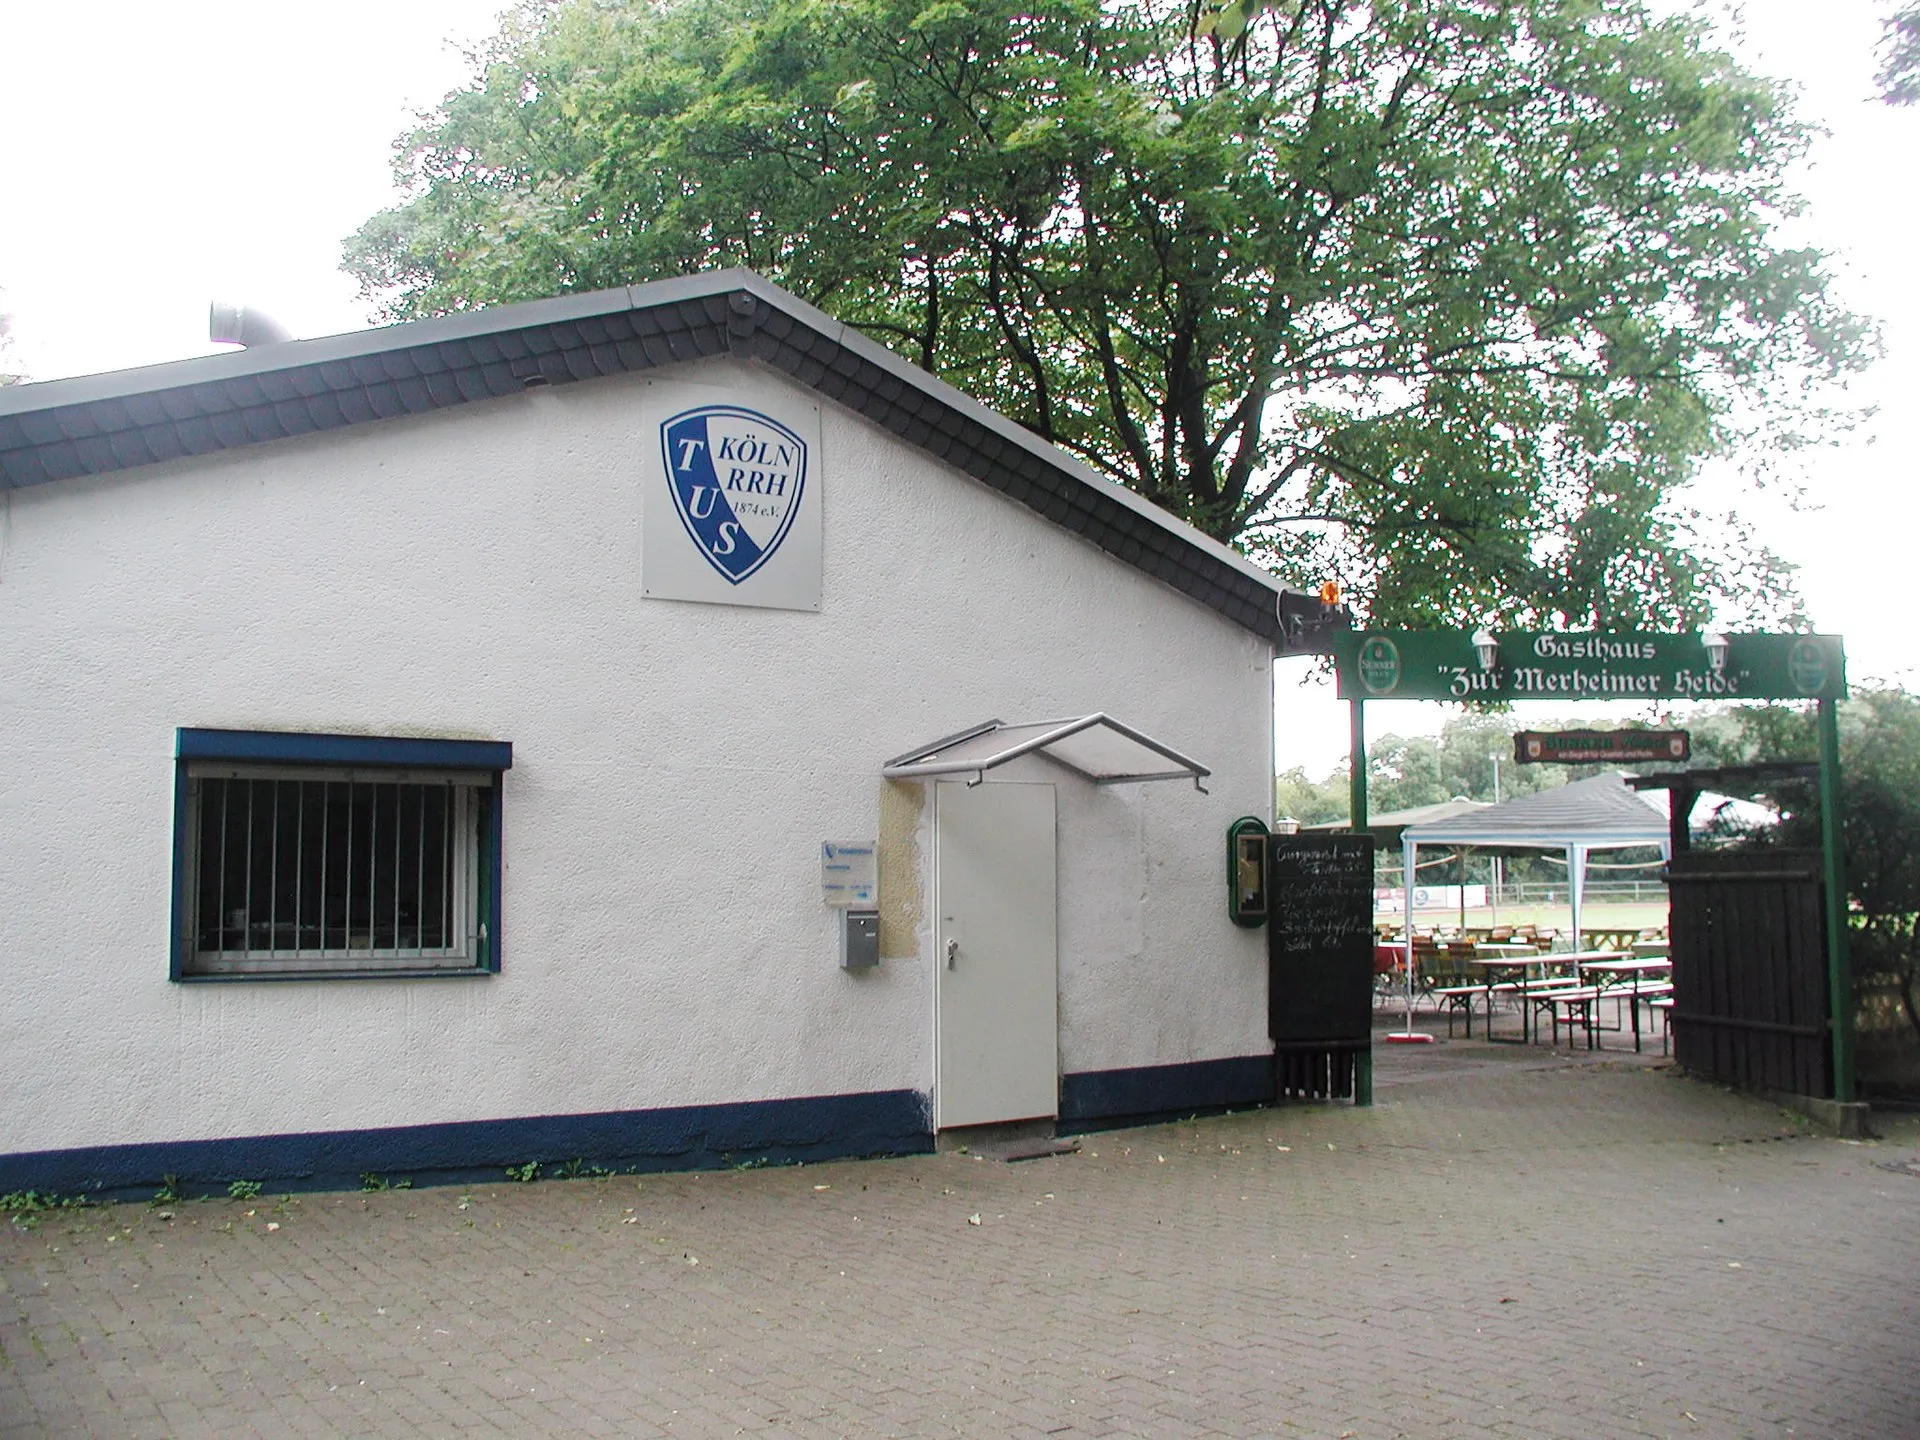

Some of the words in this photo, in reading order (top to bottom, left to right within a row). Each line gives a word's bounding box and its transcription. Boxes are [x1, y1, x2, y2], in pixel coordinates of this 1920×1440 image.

[717, 433, 795, 468] KÖLN
[726, 467, 788, 497] RRH
[734, 501, 759, 515] 1874
[760, 505, 780, 518] e.V.
[1533, 634, 1656, 663] Gasthaus
[1513, 667, 1661, 697] Merheimer
